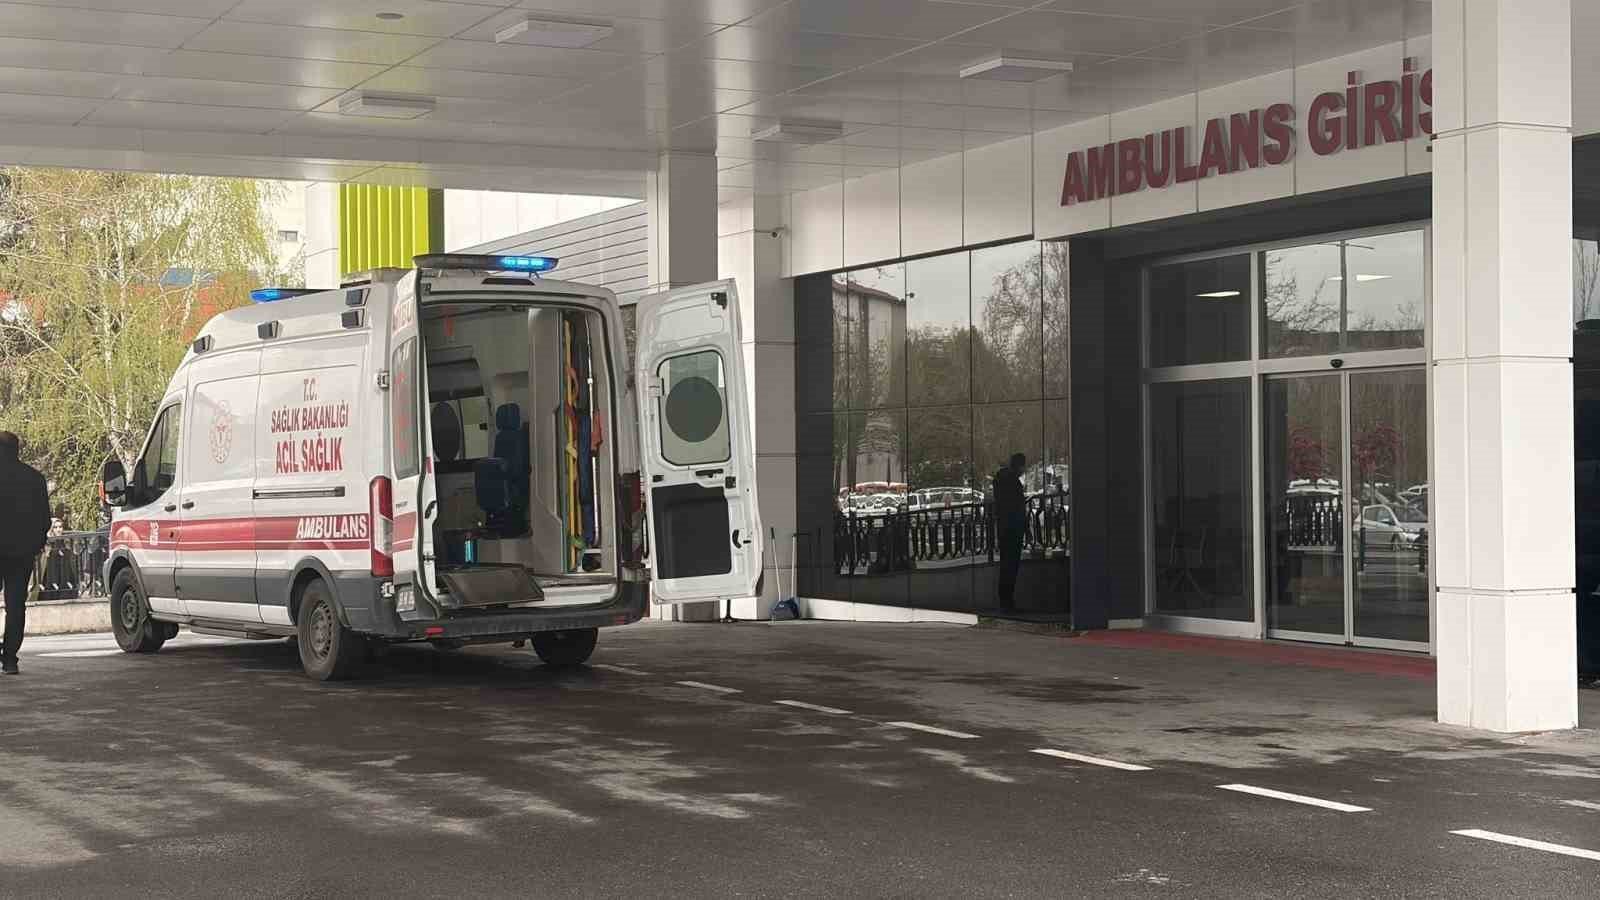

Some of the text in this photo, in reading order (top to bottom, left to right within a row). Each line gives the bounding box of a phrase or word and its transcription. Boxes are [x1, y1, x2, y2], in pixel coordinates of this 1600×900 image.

[1061, 103, 1295, 207] AMBULANS
[303, 378, 318, 401] T.C.
[271, 400, 349, 433] SAĞLIK BAKANLIĞI
[276, 432, 343, 474] ACİL SAĞLIK
[296, 515, 367, 539] AMBULANS
